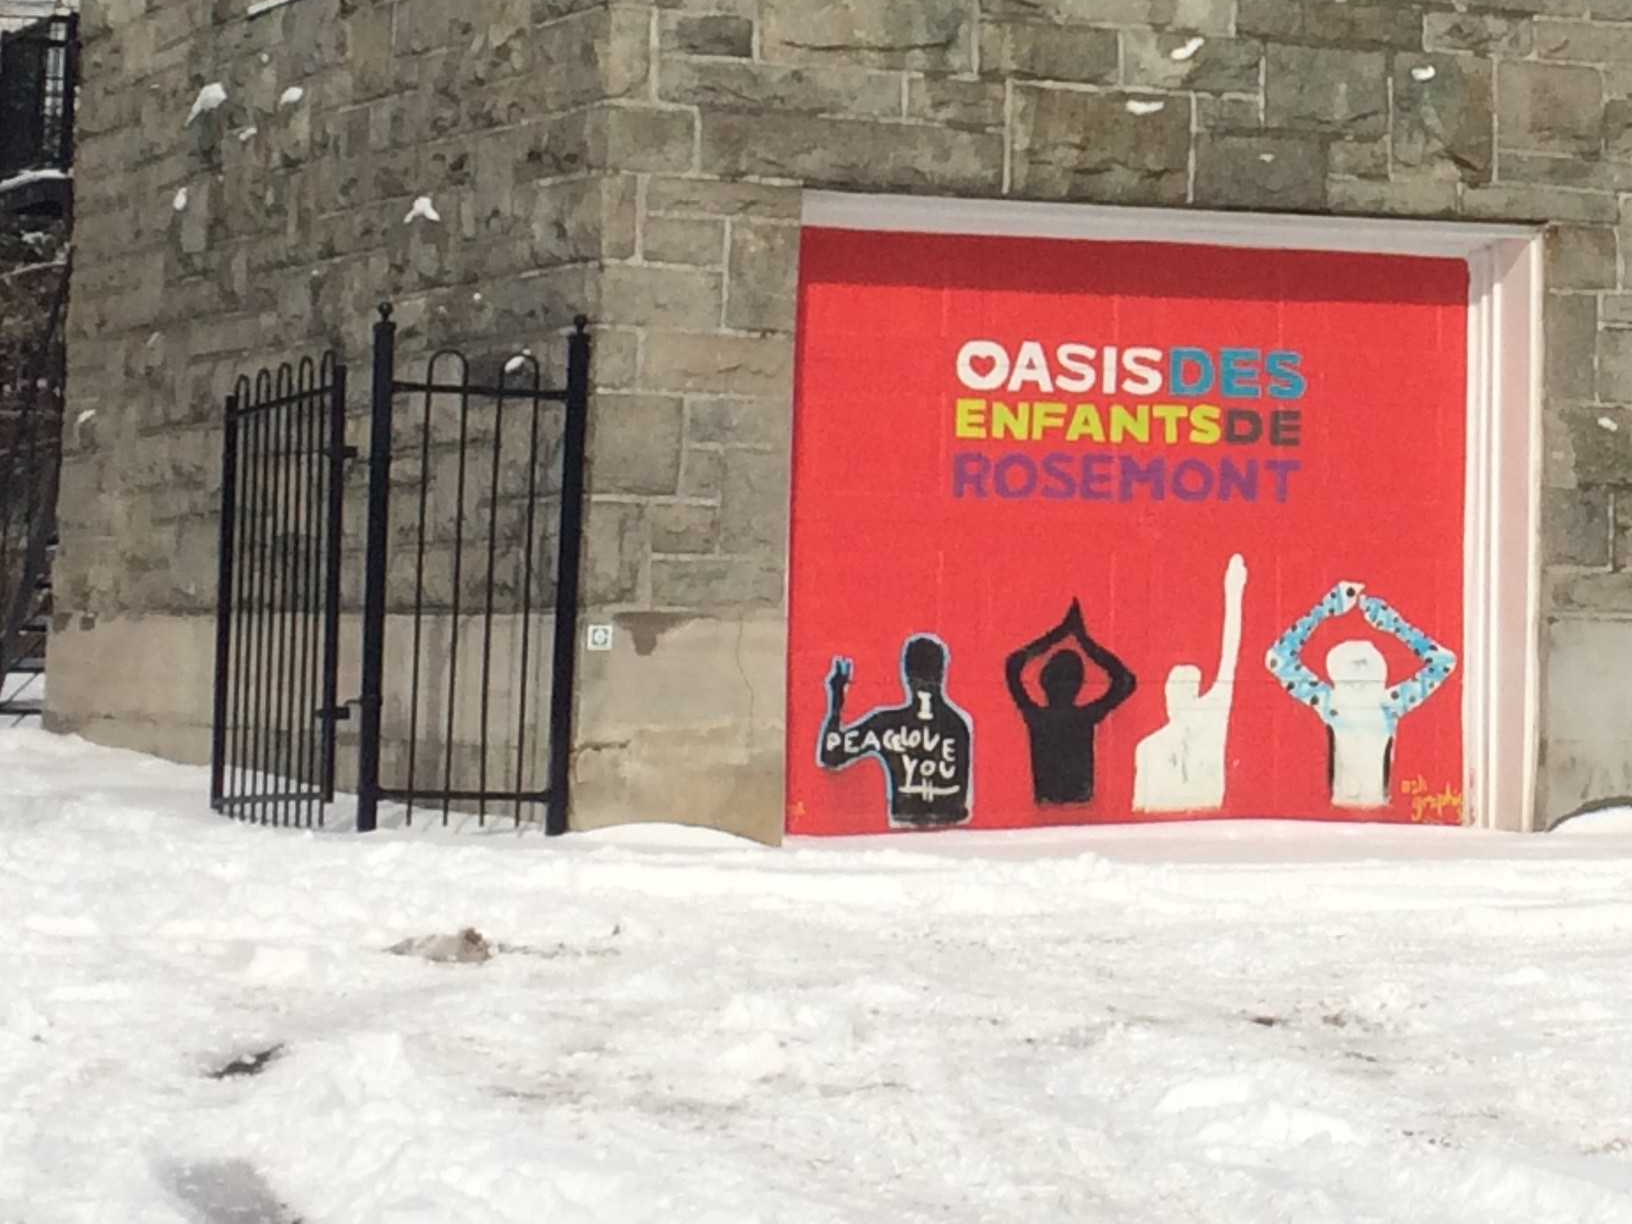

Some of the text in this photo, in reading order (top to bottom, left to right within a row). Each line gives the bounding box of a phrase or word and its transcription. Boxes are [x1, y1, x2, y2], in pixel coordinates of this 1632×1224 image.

[952, 449, 1301, 504] ROSEMONT
[916, 690, 934, 720] I
[901, 726, 957, 761] LOVE
[902, 754, 957, 788] YOU
